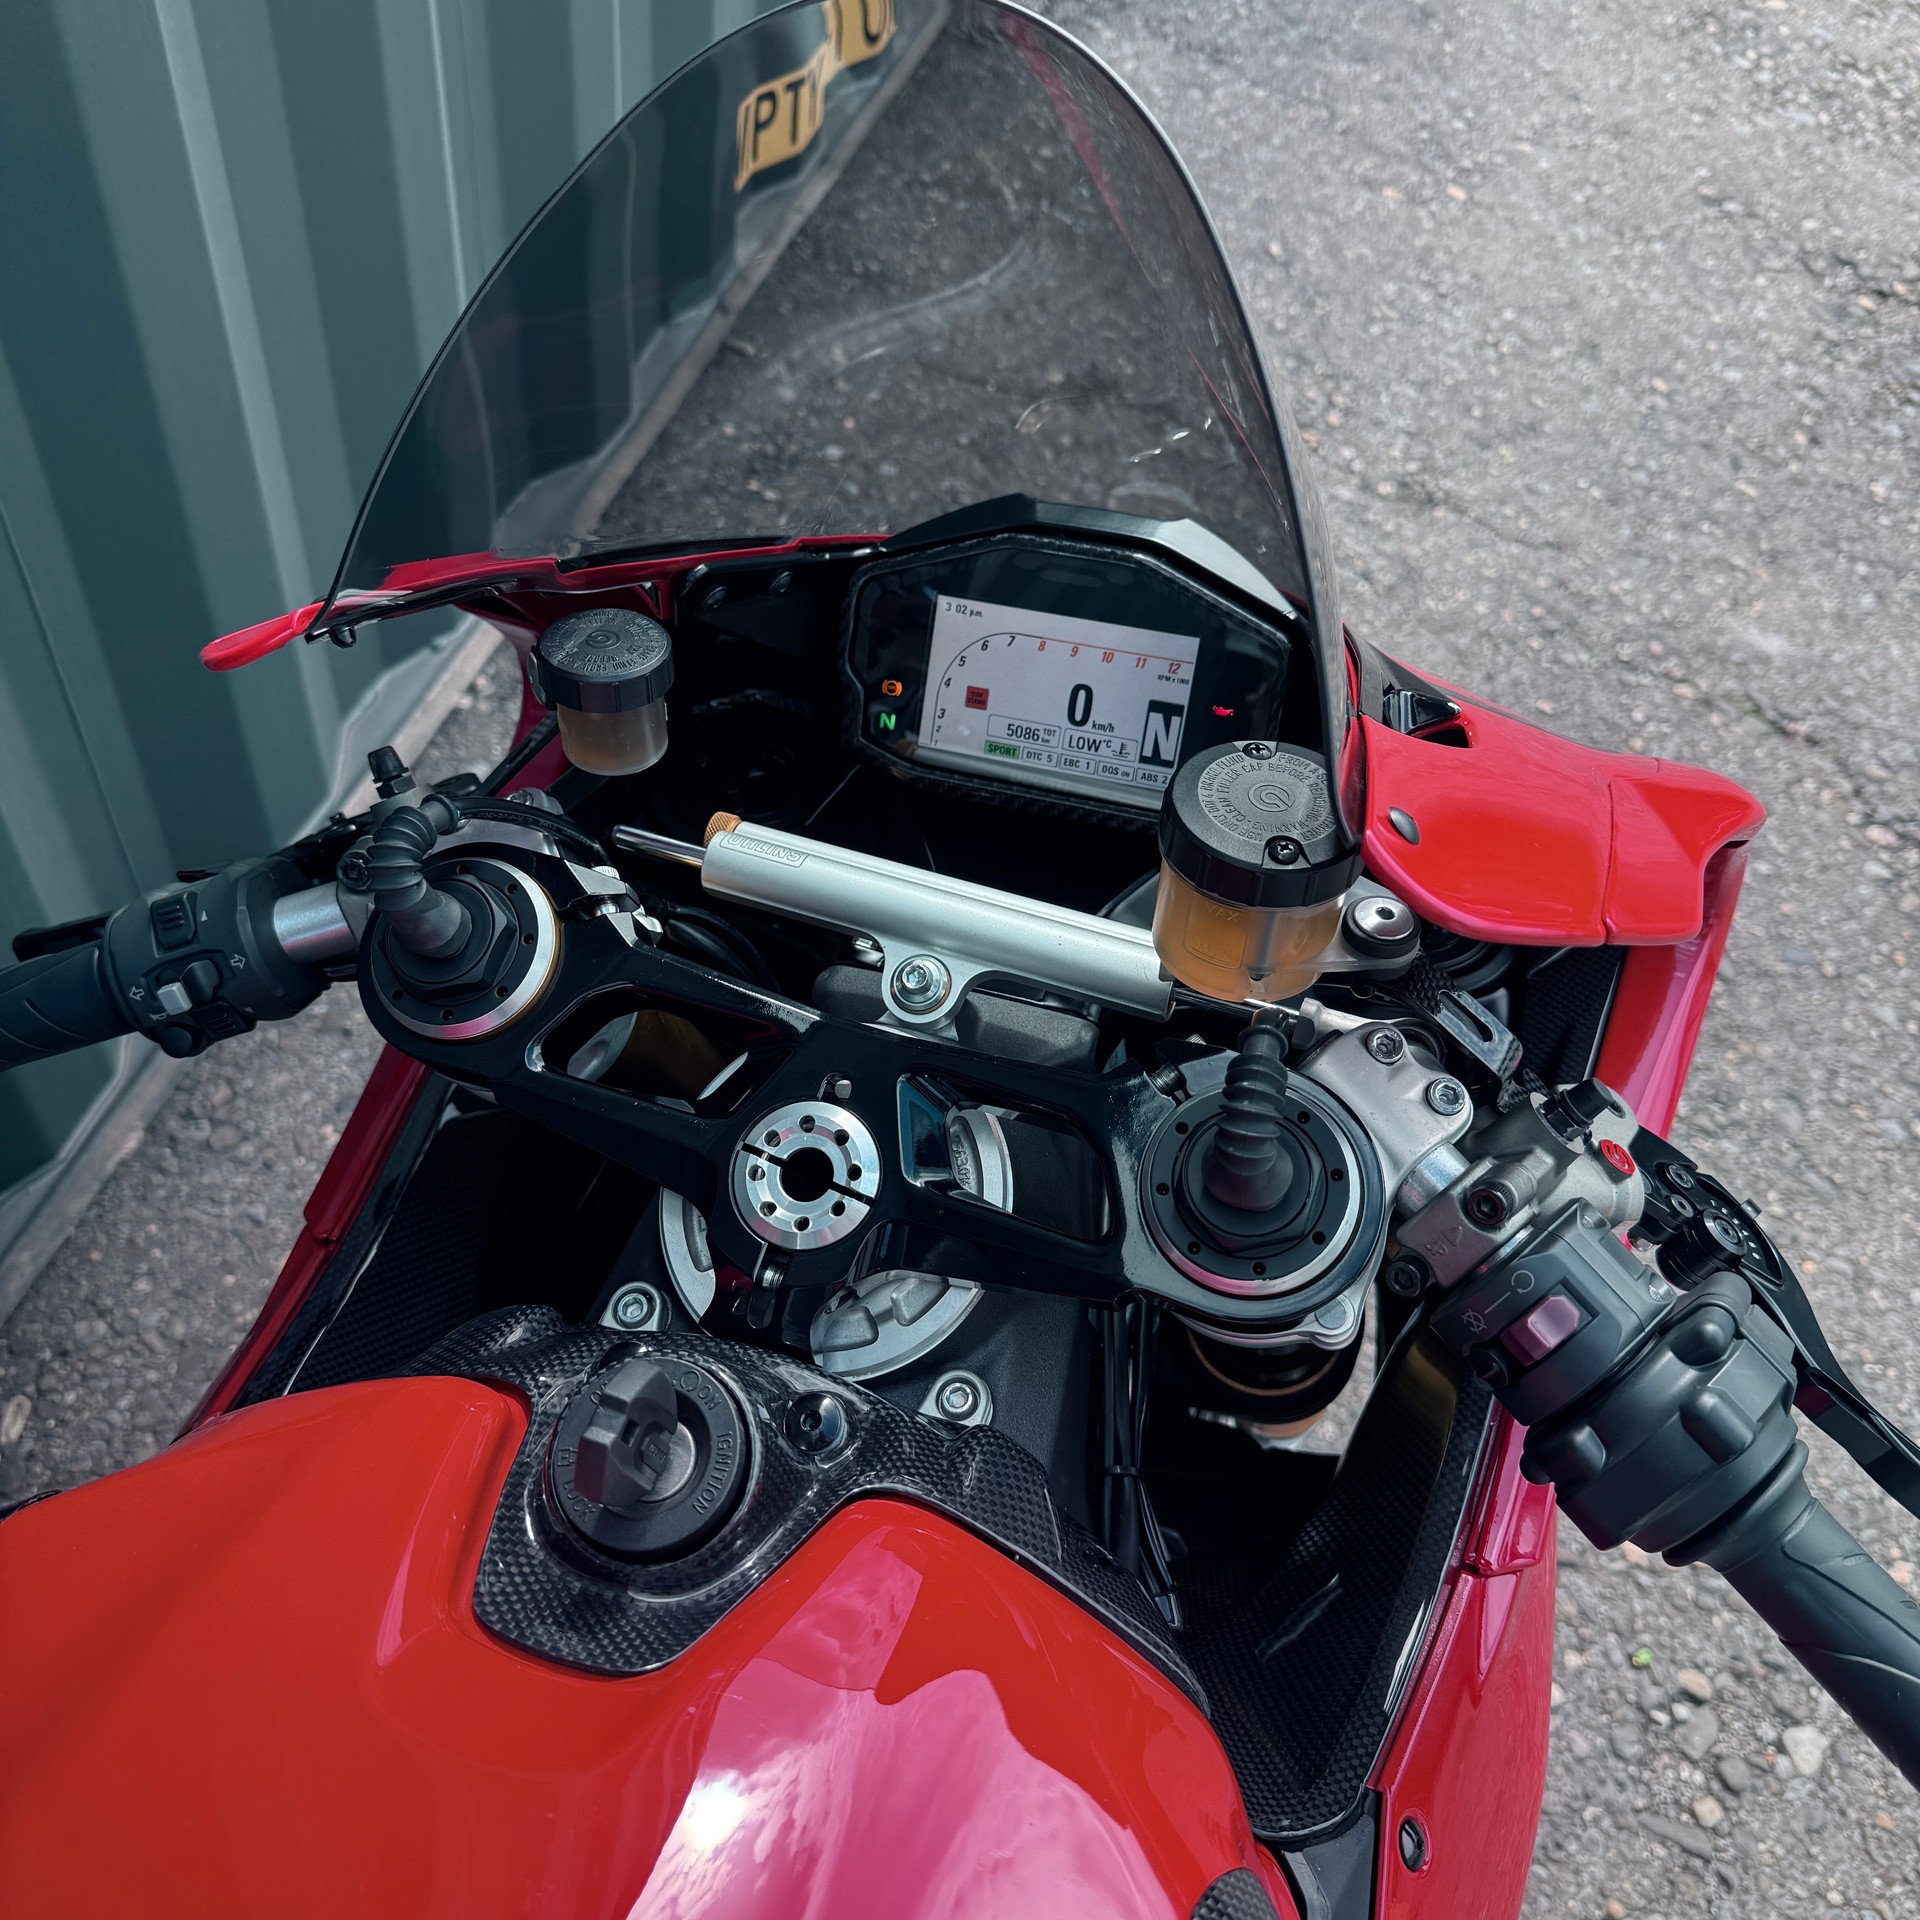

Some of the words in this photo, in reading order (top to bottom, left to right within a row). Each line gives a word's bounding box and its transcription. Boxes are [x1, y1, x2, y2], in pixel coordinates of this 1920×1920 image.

[945, 602, 952, 612] 3
[955, 604, 968, 615] 02
[981, 640, 989, 651] 6
[1007, 636, 1016, 647] 7
[1038, 640, 1047, 652] 8
[1070, 646, 1079, 657] 9
[1101, 651, 1115, 664] 10
[958, 656, 967, 667] 5
[1135, 657, 1148, 669] 11
[1167, 662, 1181, 675] 12
[944, 677, 952, 688] 4
[938, 708, 946, 719] 3
[1067, 683, 1093, 727] 0
[1092, 720, 1115, 733] km/h
[879, 712, 896, 731] N
[936, 725, 942, 733] 2
[1006, 723, 1040, 742] 5086
[1043, 728, 1057, 737] TOT
[1142, 711, 1181, 761] N
[987, 743, 1017, 757] SPORT
[1068, 735, 1102, 753] LOW
[1026, 751, 1042, 762] DTC
[1047, 754, 1053, 763] 5
[1216, 754, 1245, 772] FLUID
[1279, 754, 1311, 770] FROM
[1063, 758, 1080, 768] EBC
[1085, 762, 1090, 770] 1
[1101, 765, 1119, 776] DQS
[1140, 772, 1158, 783] ABS
[1161, 775, 1168, 785] 2
[1217, 768, 1243, 793] FILLER
[1241, 763, 1263, 773] CAP
[1268, 762, 1311, 782] BEFORE
[699, 1385, 722, 1411] ON
[691, 1430, 733, 1515] IGNITION
[563, 1480, 597, 1522] LOCK
